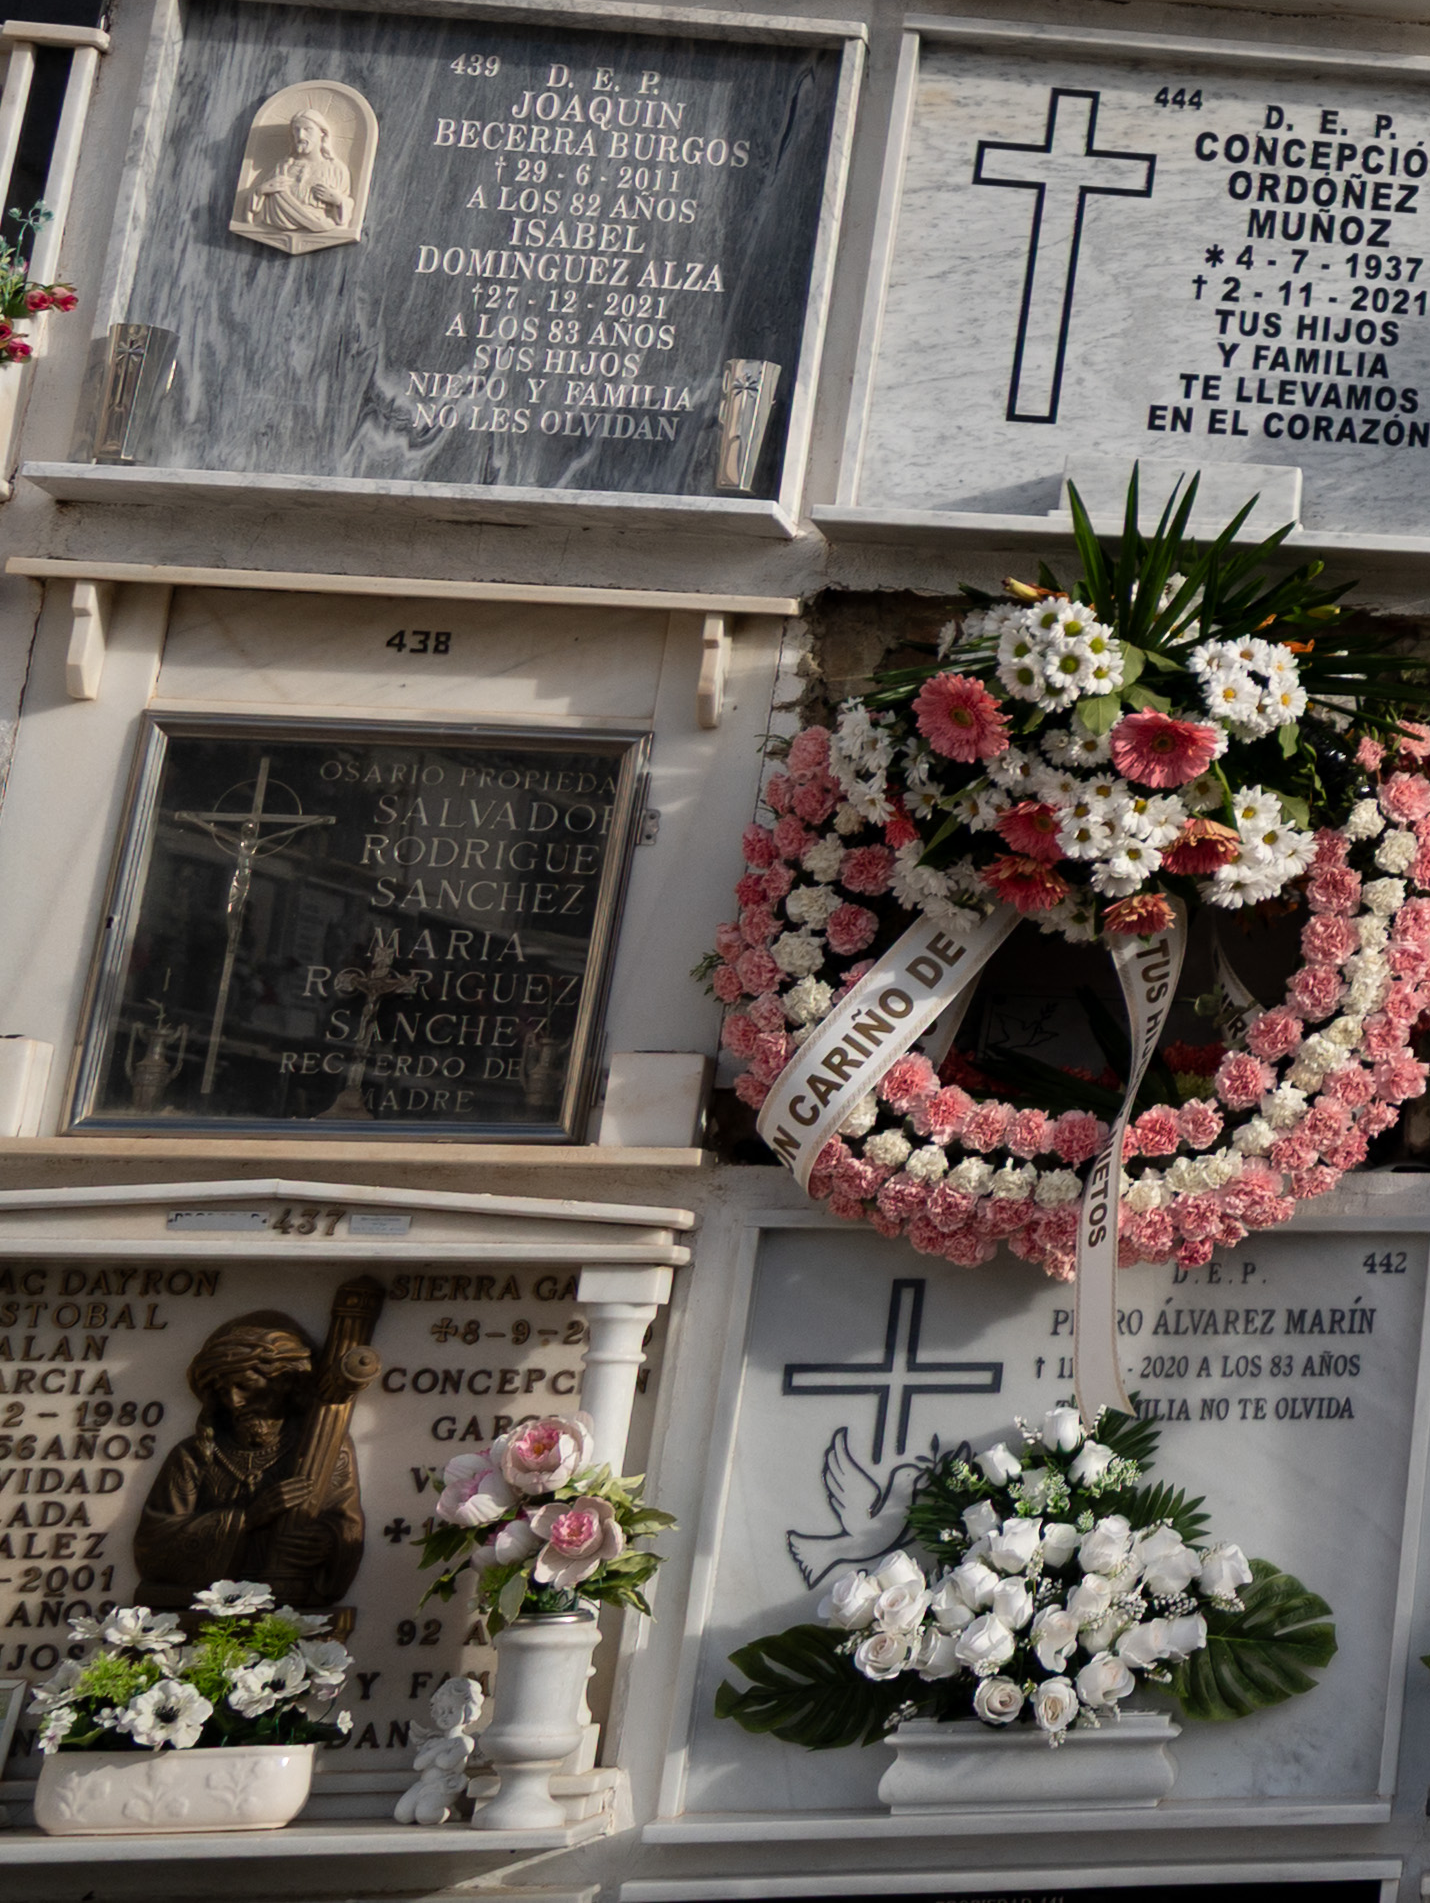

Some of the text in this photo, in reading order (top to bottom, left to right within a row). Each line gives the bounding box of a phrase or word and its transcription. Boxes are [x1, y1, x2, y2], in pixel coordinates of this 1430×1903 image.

[450, 53, 500, 78] 439
[511, 92, 686, 129] JOAQUIN
[1154, 87, 1204, 109] 444
[433, 119, 751, 169] BECERRA BURGOS
[1228, 171, 1419, 214] ORDÓÑEZ
[508, 218, 646, 254] ISABEL
[1247, 208, 1392, 248] MUÑOZ
[414, 247, 725, 293] DOMINGUEZ ALZA
[404, 373, 695, 412] NIETO Y FAMILIA
[1180, 373, 1419, 414] TE LLEVAMOS
[1148, 406, 1193, 432] EN
[1208, 410, 1249, 436] EL
[386, 630, 452, 655] 438
[320, 761, 445, 786] OSARIO
[369, 876, 586, 915] SANCHEZ
[1134, 937, 1172, 1012] TUS
[788, 930, 966, 1128] CARIÑO DE
[1362, 1252, 1408, 1274] 442
[1152, 1296, 1376, 1336] ÁLVAREZ MARÍN
